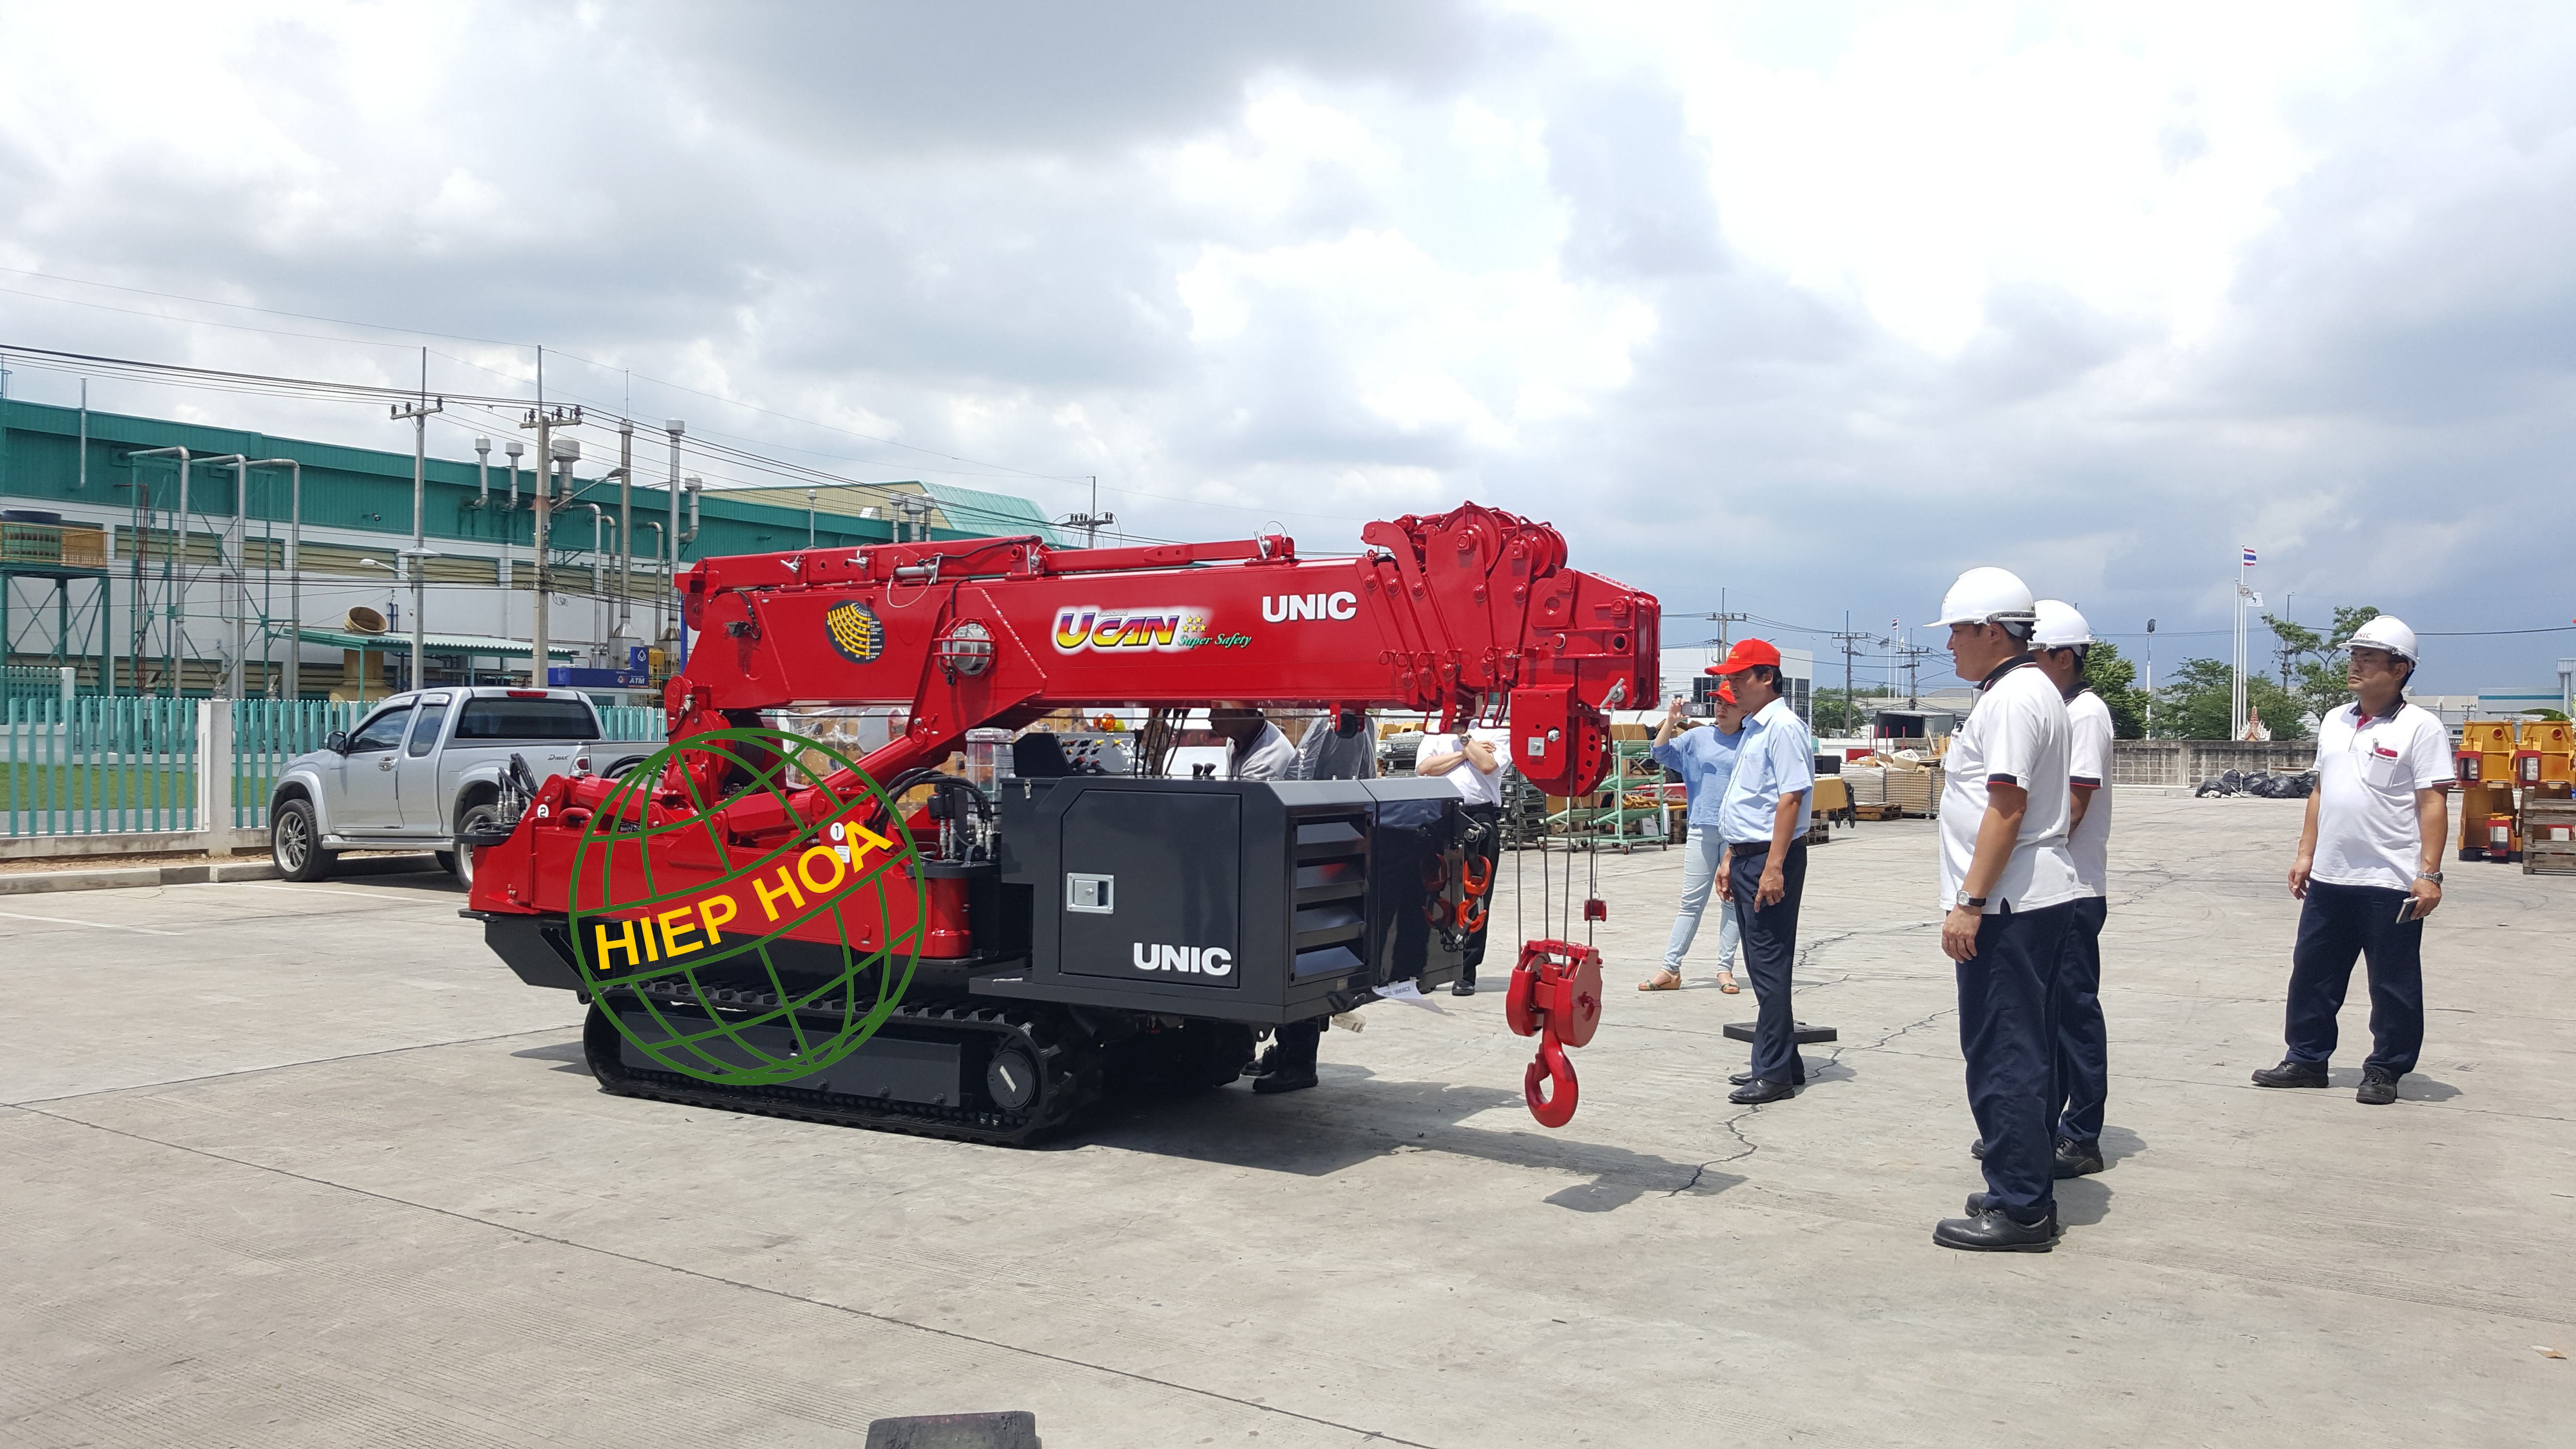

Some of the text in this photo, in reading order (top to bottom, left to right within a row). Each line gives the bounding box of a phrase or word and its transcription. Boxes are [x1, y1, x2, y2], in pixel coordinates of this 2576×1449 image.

[1262, 591, 1357, 622] UNIC
[1177, 632, 1252, 649] Super Safety
[540, 807, 546, 817] 2
[835, 825, 839, 838] 1
[1134, 942, 1231, 975] UNIC
